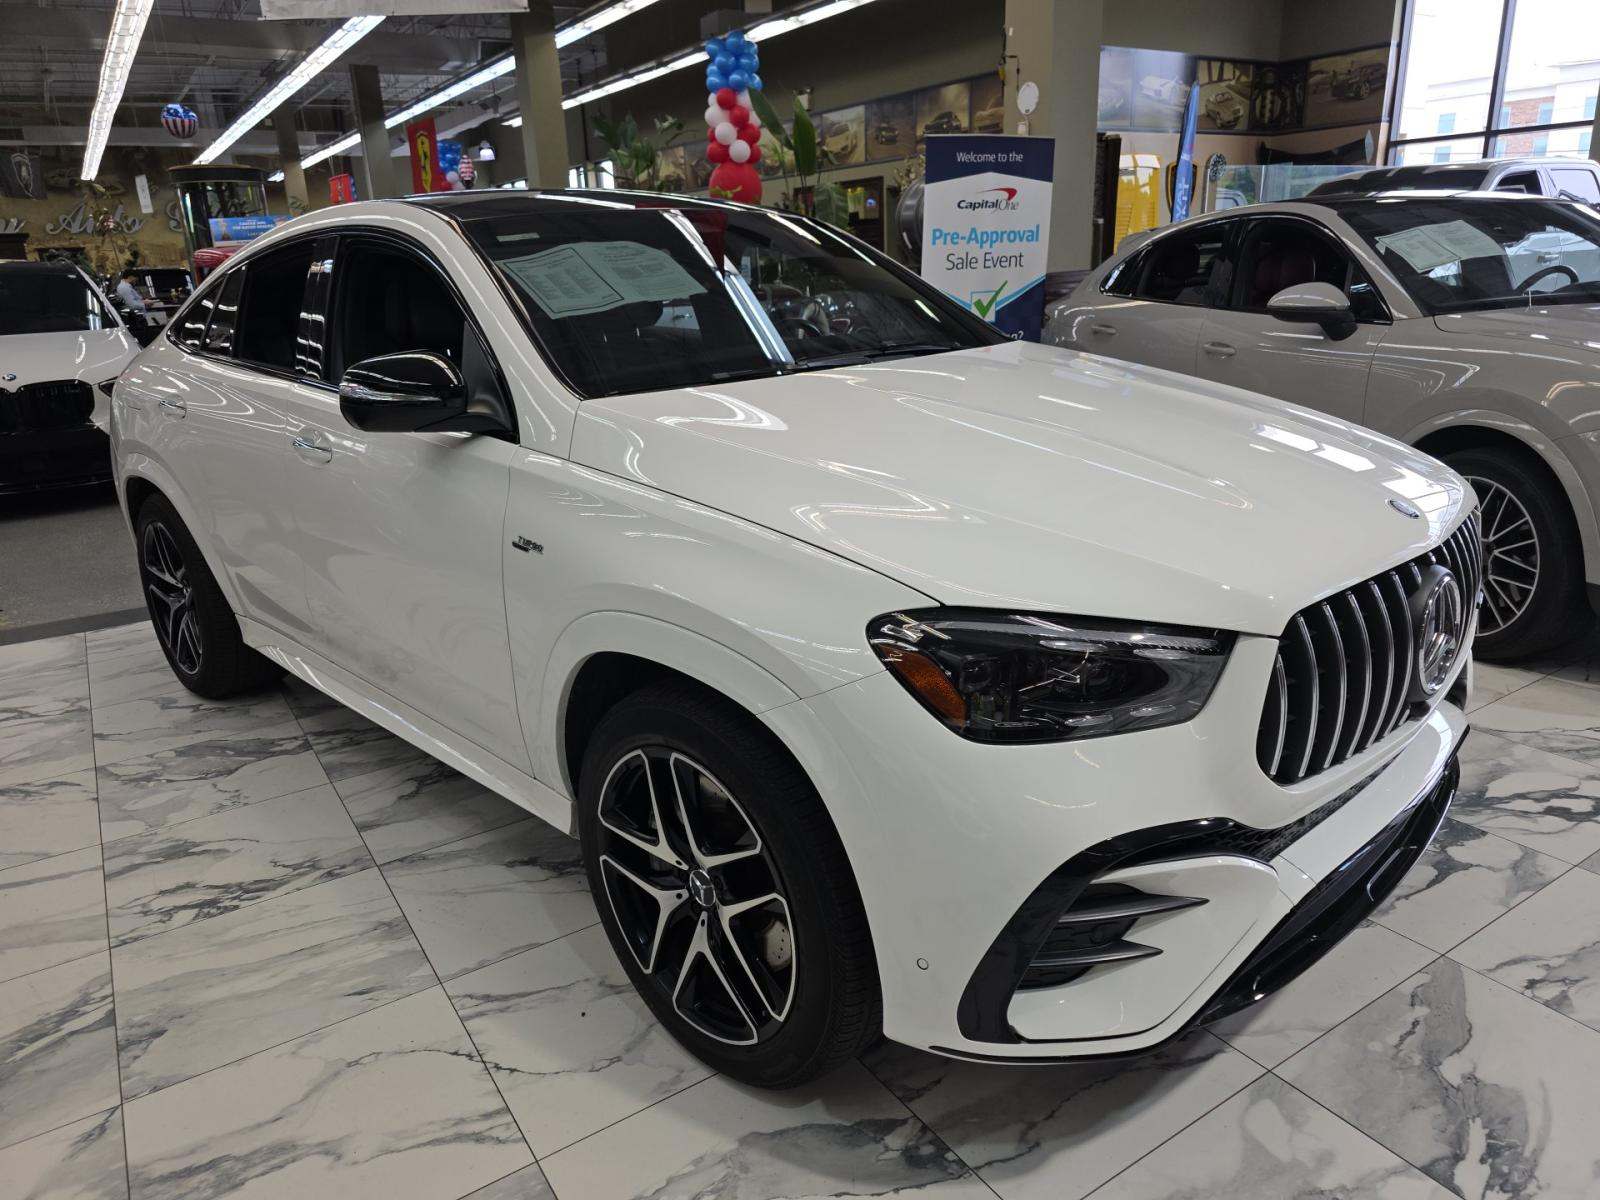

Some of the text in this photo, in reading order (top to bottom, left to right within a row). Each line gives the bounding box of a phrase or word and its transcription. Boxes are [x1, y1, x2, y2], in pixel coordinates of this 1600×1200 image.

[956, 151, 1024, 163] Welcome to the
[931, 224, 1040, 249] Pre-Approval
[945, 252, 1025, 271] Sale Event
